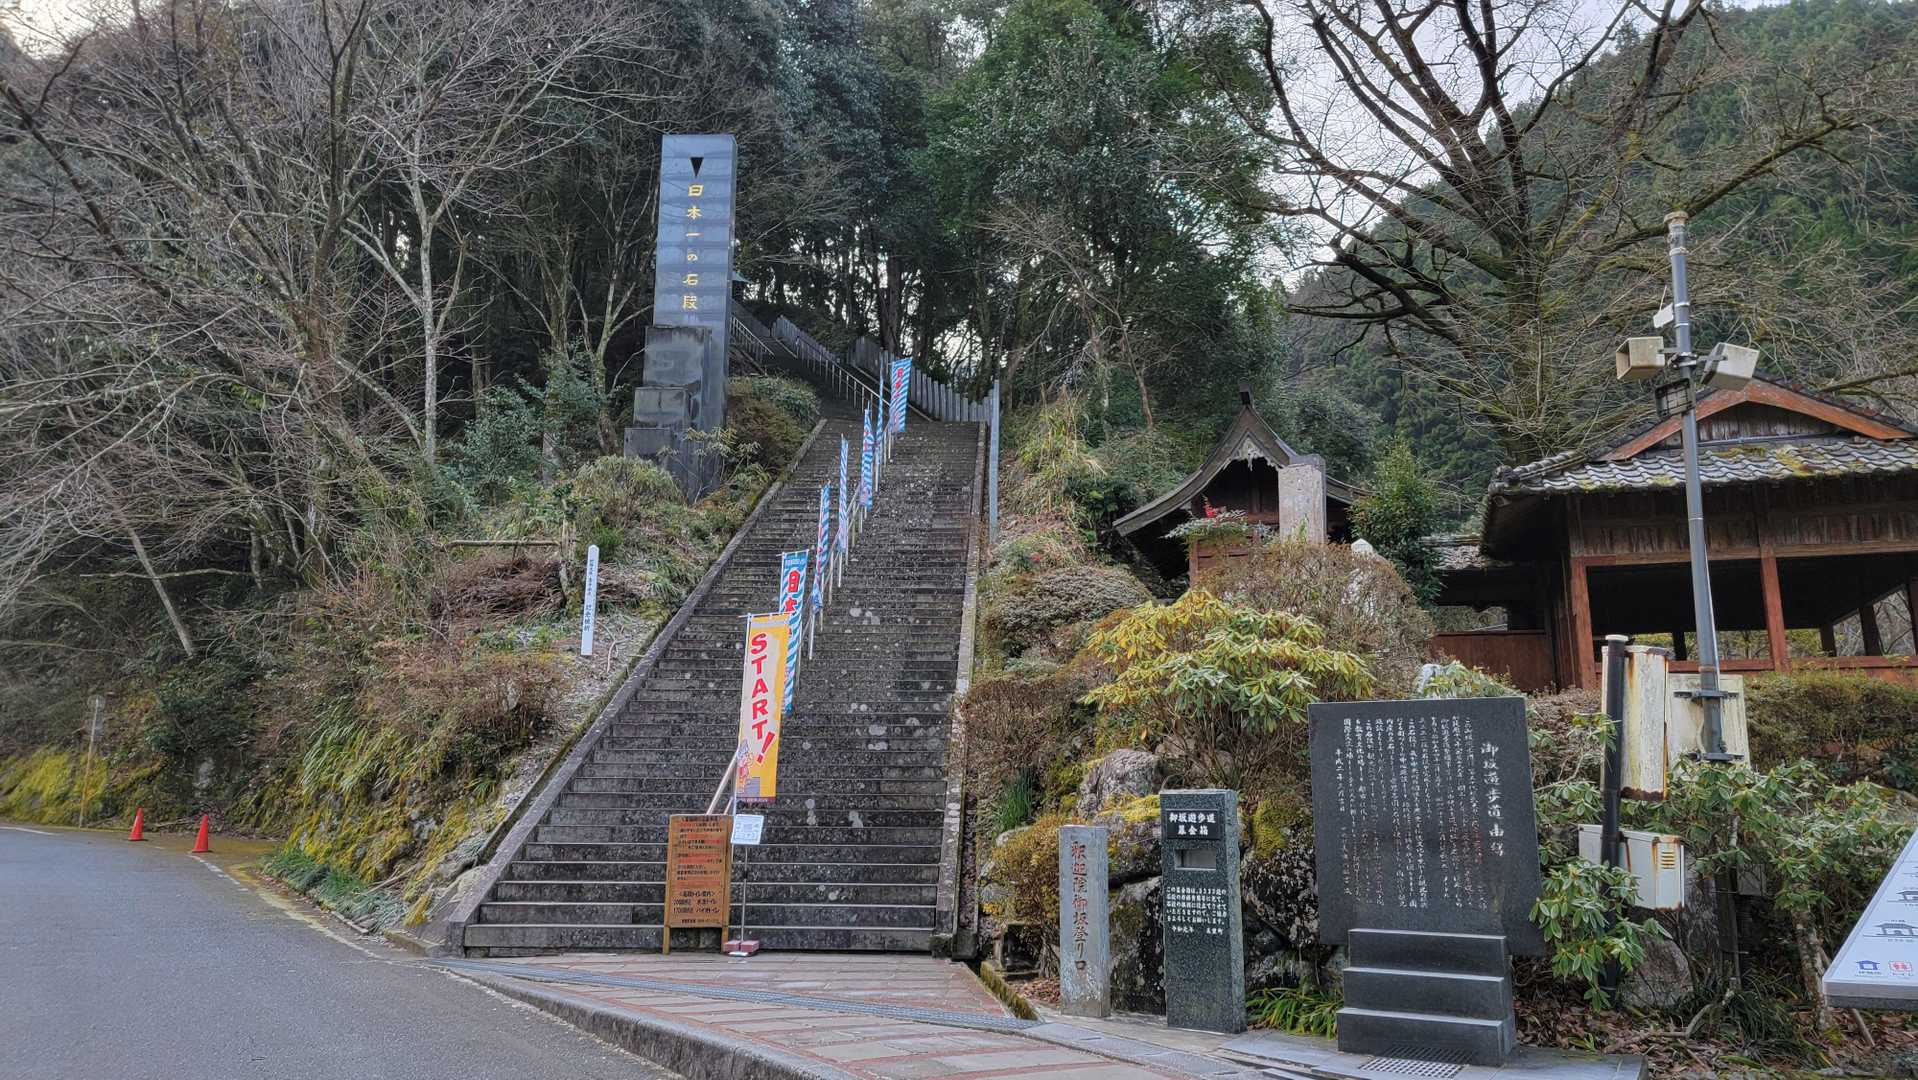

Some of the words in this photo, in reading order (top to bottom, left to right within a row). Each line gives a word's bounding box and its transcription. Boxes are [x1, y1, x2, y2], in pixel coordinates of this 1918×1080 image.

[682, 184, 704, 310] 日本一の石段
[750, 632, 776, 765] START!
[1169, 812, 1216, 824] 御坂遊歩道
[1178, 824, 1208, 836] 募金箱
